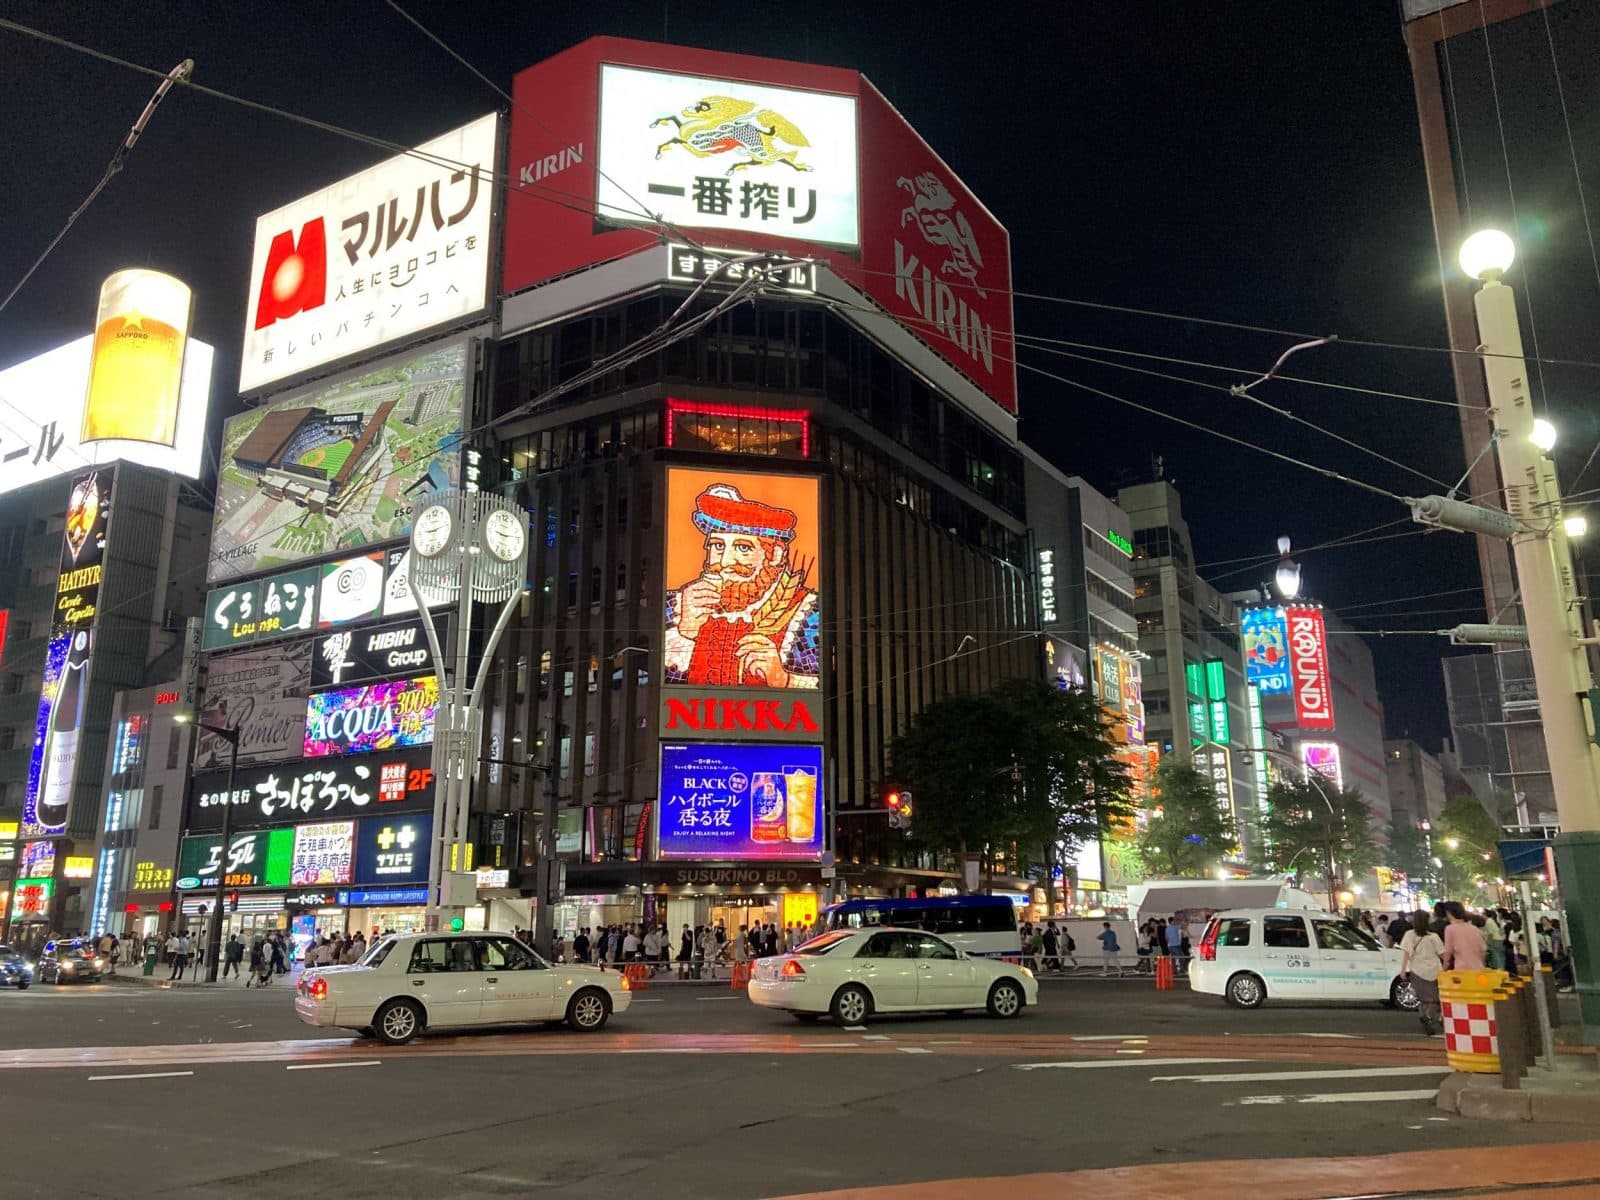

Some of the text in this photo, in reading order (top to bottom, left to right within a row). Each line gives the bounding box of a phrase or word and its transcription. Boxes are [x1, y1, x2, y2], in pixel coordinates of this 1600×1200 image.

[519, 143, 583, 187] KIRIN
[341, 162, 480, 266] マルハン
[648, 176, 817, 225] 一番搾り
[335, 235, 478, 302] 人生にヨロコビを
[894, 238, 994, 375] KIRIN
[116, 332, 149, 340] SAPPORO
[263, 284, 460, 365] 新しいパチンコへ
[0, 421, 64, 466] ール
[225, 542, 259, 560] VILLAGE
[214, 582, 299, 630] くろねこ
[233, 616, 280, 638] Lounge
[368, 628, 416, 651] HIBIKI
[322, 631, 355, 684] 響
[388, 648, 427, 668] Group
[1292, 617, 1330, 720] ROUND1
[311, 703, 394, 740] ACQUA
[664, 697, 821, 732] NIKKA
[256, 766, 371, 815] さっぽろっこ
[408, 769, 433, 790] 2F
[683, 777, 727, 790] BLACK
[668, 792, 742, 808] ハイボール
[677, 808, 732, 827] 香る夜
[296, 852, 350, 869] 恵美須商店
[297, 836, 346, 852] 元祖串かつ
[677, 868, 800, 883] SUSUKINO BLD.
